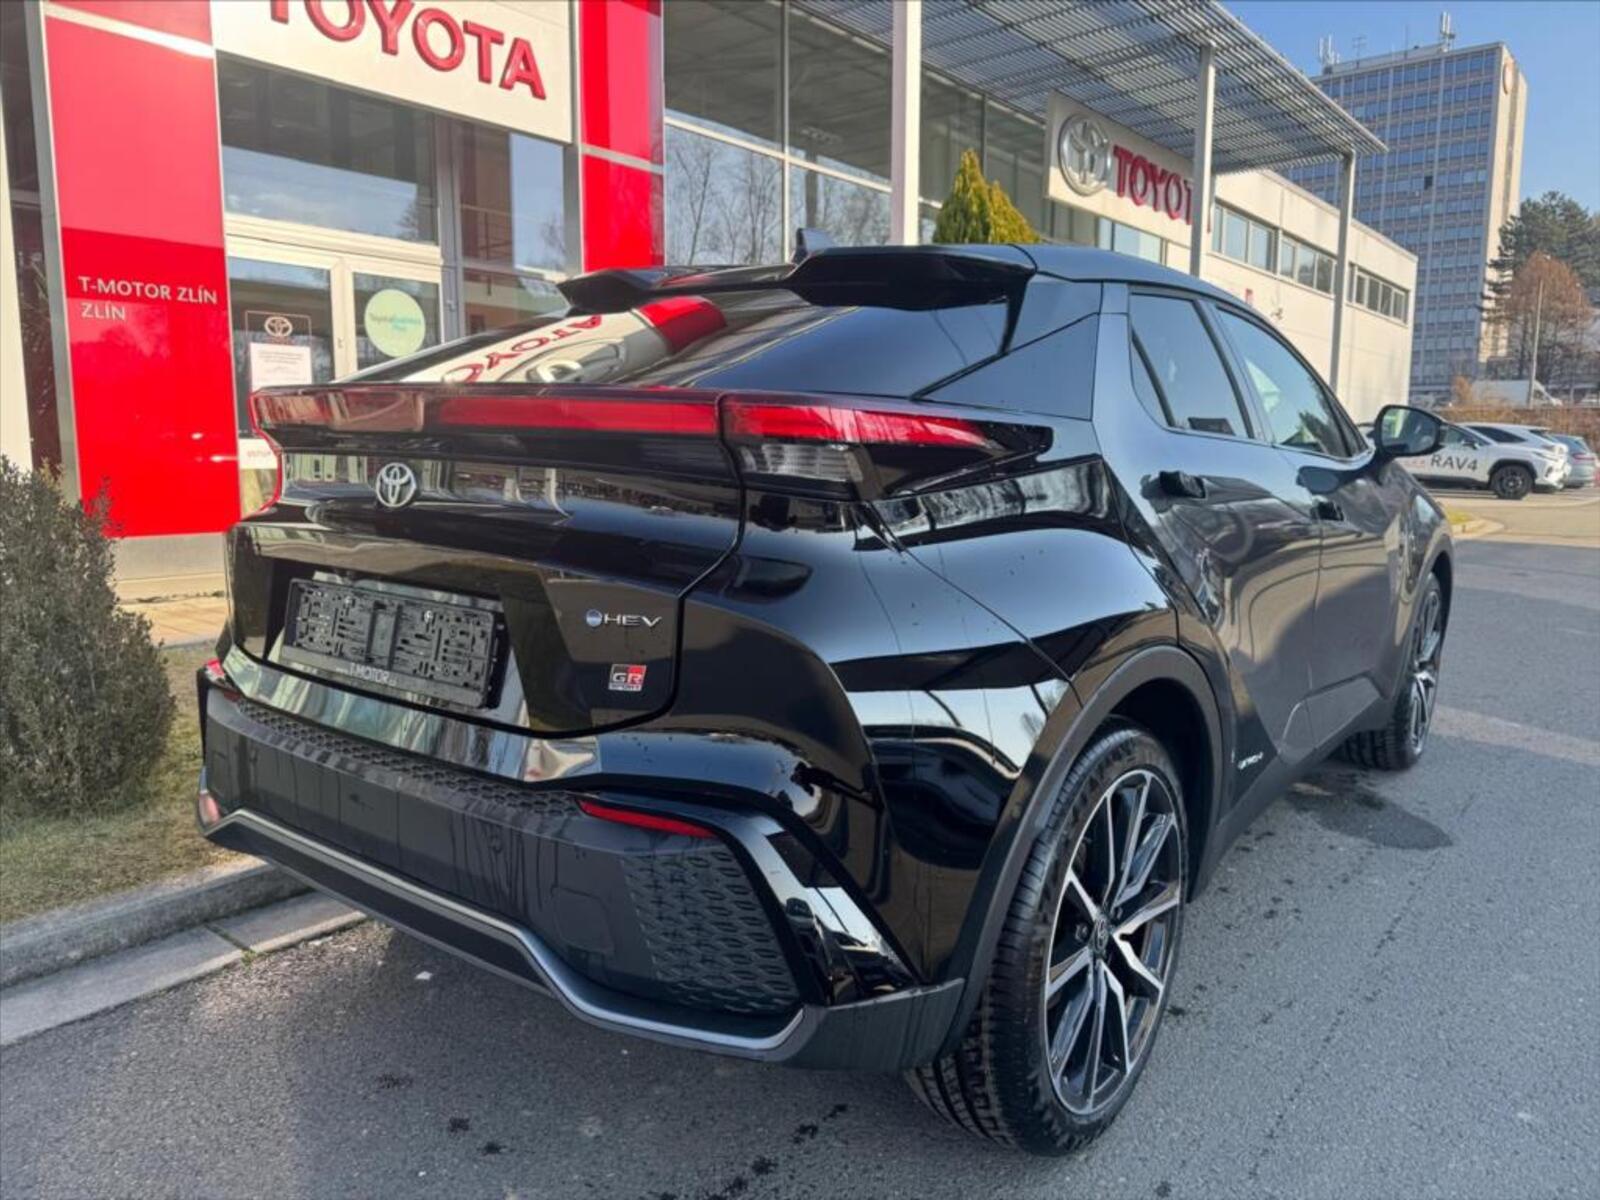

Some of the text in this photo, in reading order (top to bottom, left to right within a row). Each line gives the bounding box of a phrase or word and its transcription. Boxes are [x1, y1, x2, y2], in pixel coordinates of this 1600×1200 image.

[1112, 144, 1211, 234] TOYOT
[78, 275, 218, 305] T-MOTOR ZLÍN
[81, 300, 126, 321] ZLÍN
[1430, 454, 1478, 471] RAV4
[603, 613, 662, 627] HEV
[612, 672, 643, 685] GR
